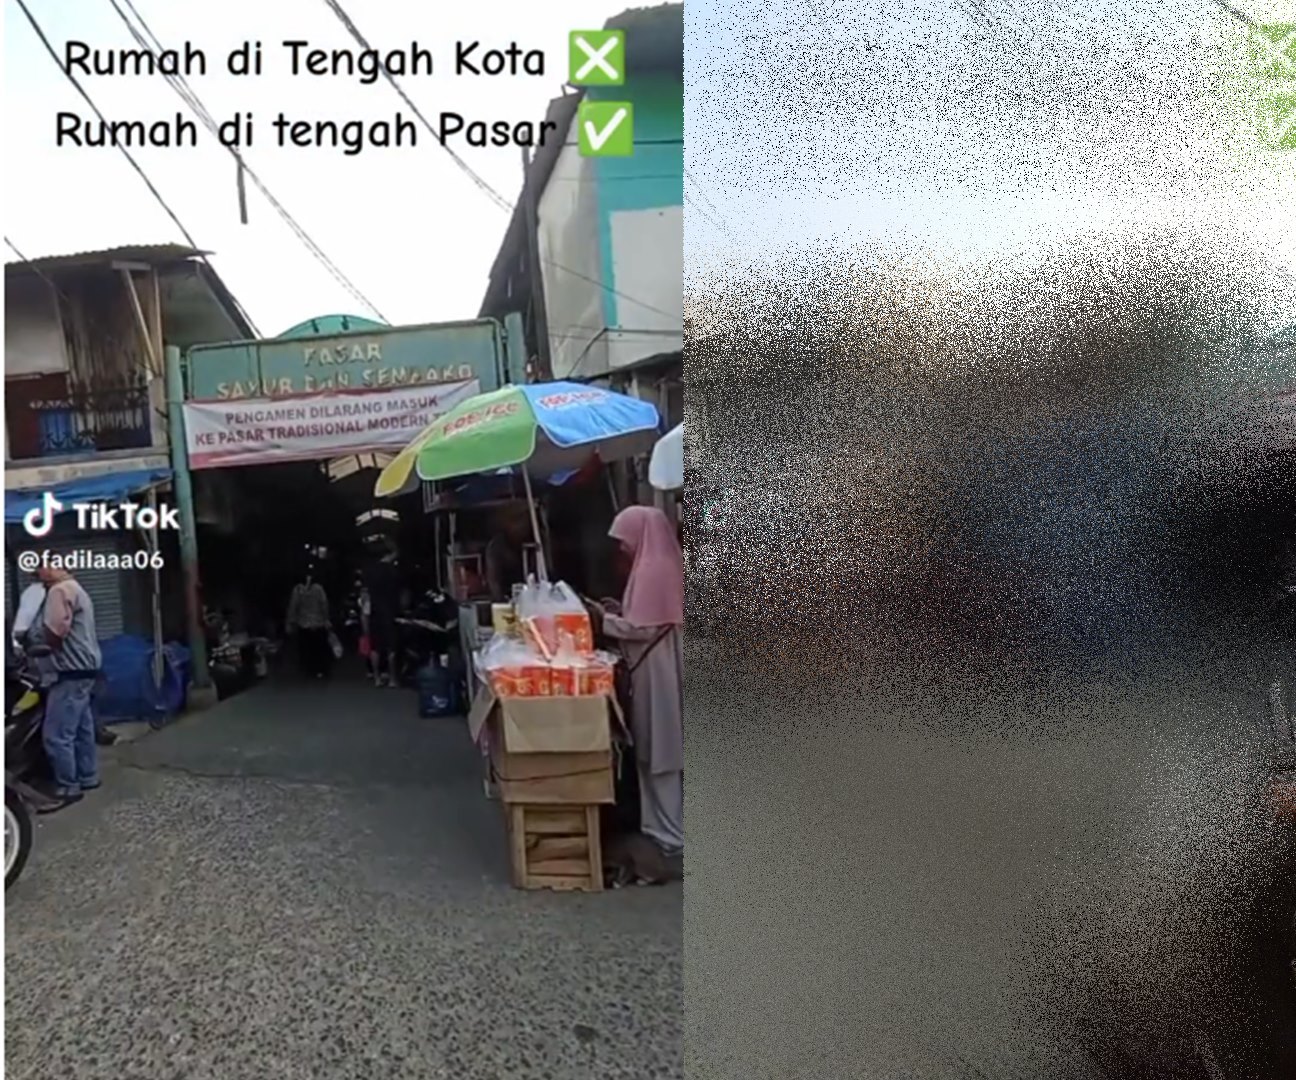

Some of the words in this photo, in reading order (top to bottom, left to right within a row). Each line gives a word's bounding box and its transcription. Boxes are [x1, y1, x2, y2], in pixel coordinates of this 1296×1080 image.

[225, 406, 305, 424] PENGAMEN
[310, 400, 382, 418] DILARANG
[387, 395, 438, 411] MASUK
[195, 430, 215, 446] KE
[218, 427, 265, 444] PASAR
[268, 420, 364, 440] TRADISIONAL
[368, 413, 428, 431] MODERN
